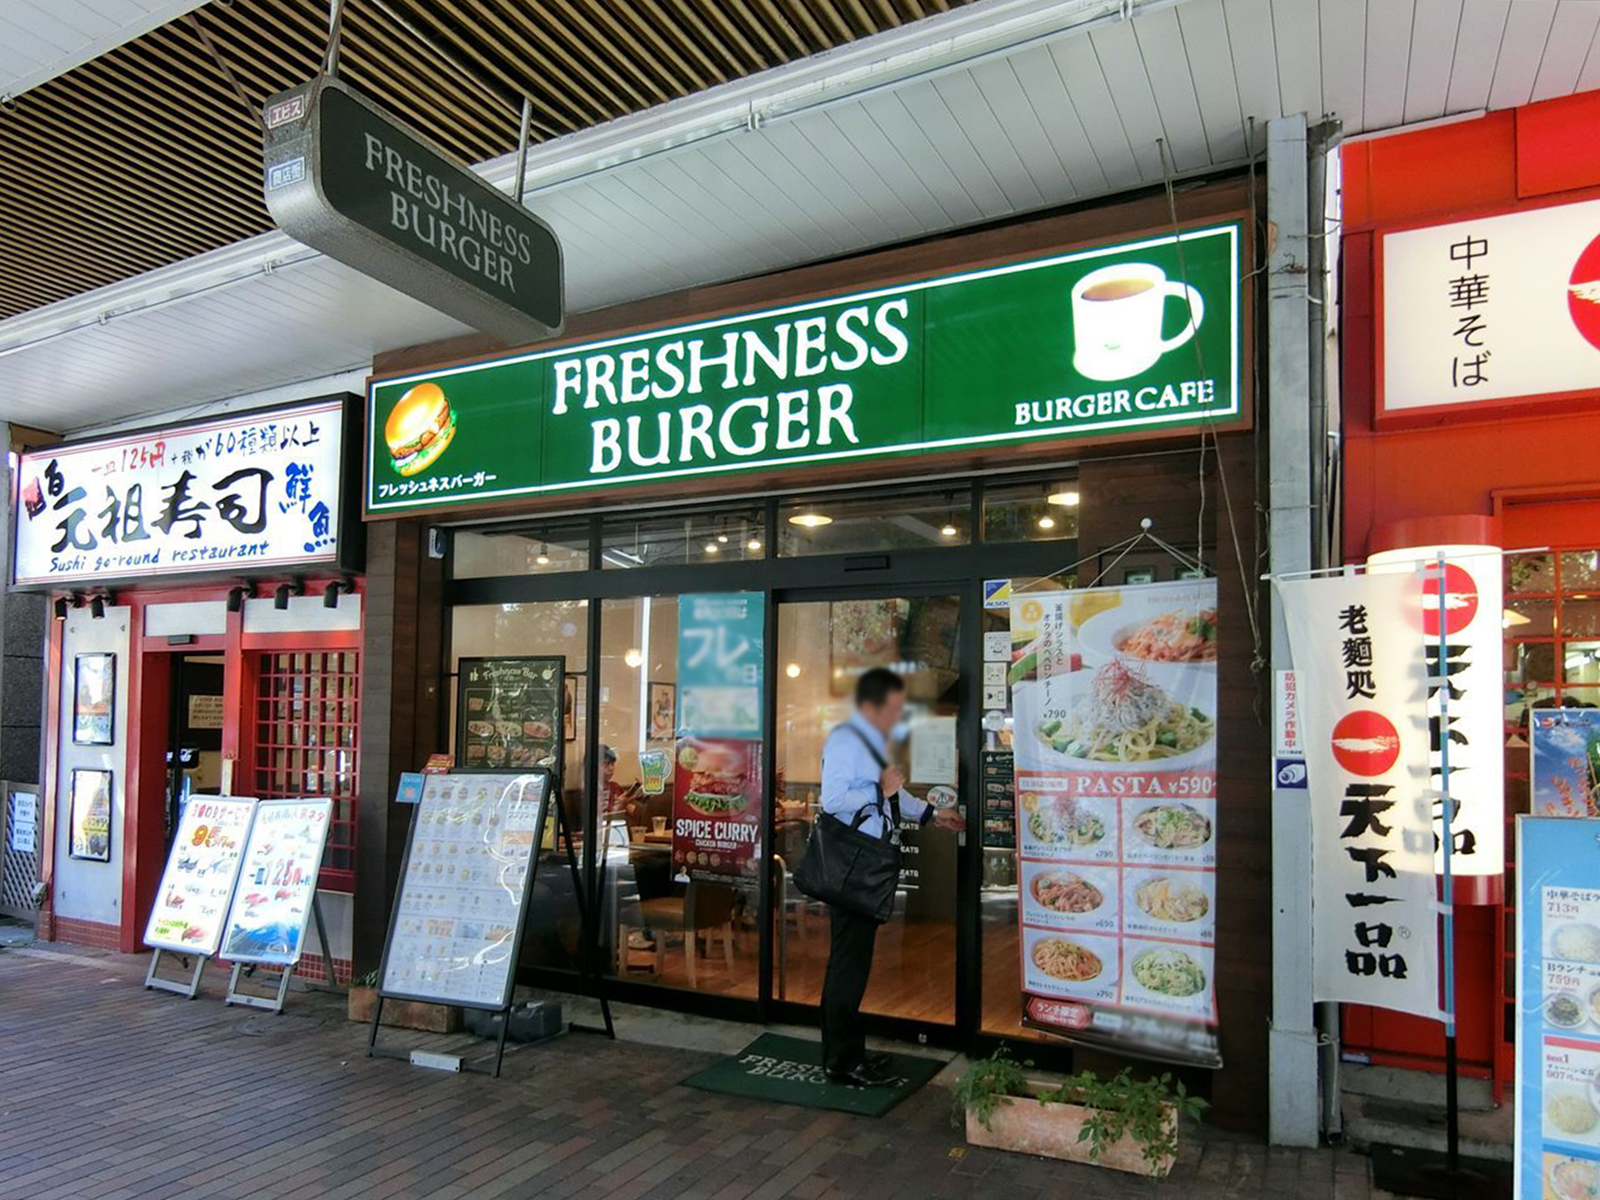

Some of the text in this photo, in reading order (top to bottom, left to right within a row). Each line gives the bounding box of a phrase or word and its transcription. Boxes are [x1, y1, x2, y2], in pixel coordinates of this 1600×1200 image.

[272, 101, 301, 124] エビス
[365, 132, 531, 265] FRESHNESS
[391, 191, 515, 293] BURGER
[1449, 235, 1491, 387] 中華そば
[552, 299, 909, 415] FRESHNESS
[589, 383, 858, 473] BURGER
[1015, 379, 1215, 425] BURGER CAFE
[50, 467, 275, 553] 元祖寿司
[279, 462, 337, 553] 鮮魚
[379, 471, 497, 497] フレッシュネスバーガー
[50, 541, 270, 573] Sushi go-round restaurant
[1283, 672, 1297, 748] 防犯カメラ作動中
[1076, 777, 1164, 794] PASTA
[676, 818, 758, 843] SPICE CURRY
[1340, 783, 1408, 979] 天下一品
